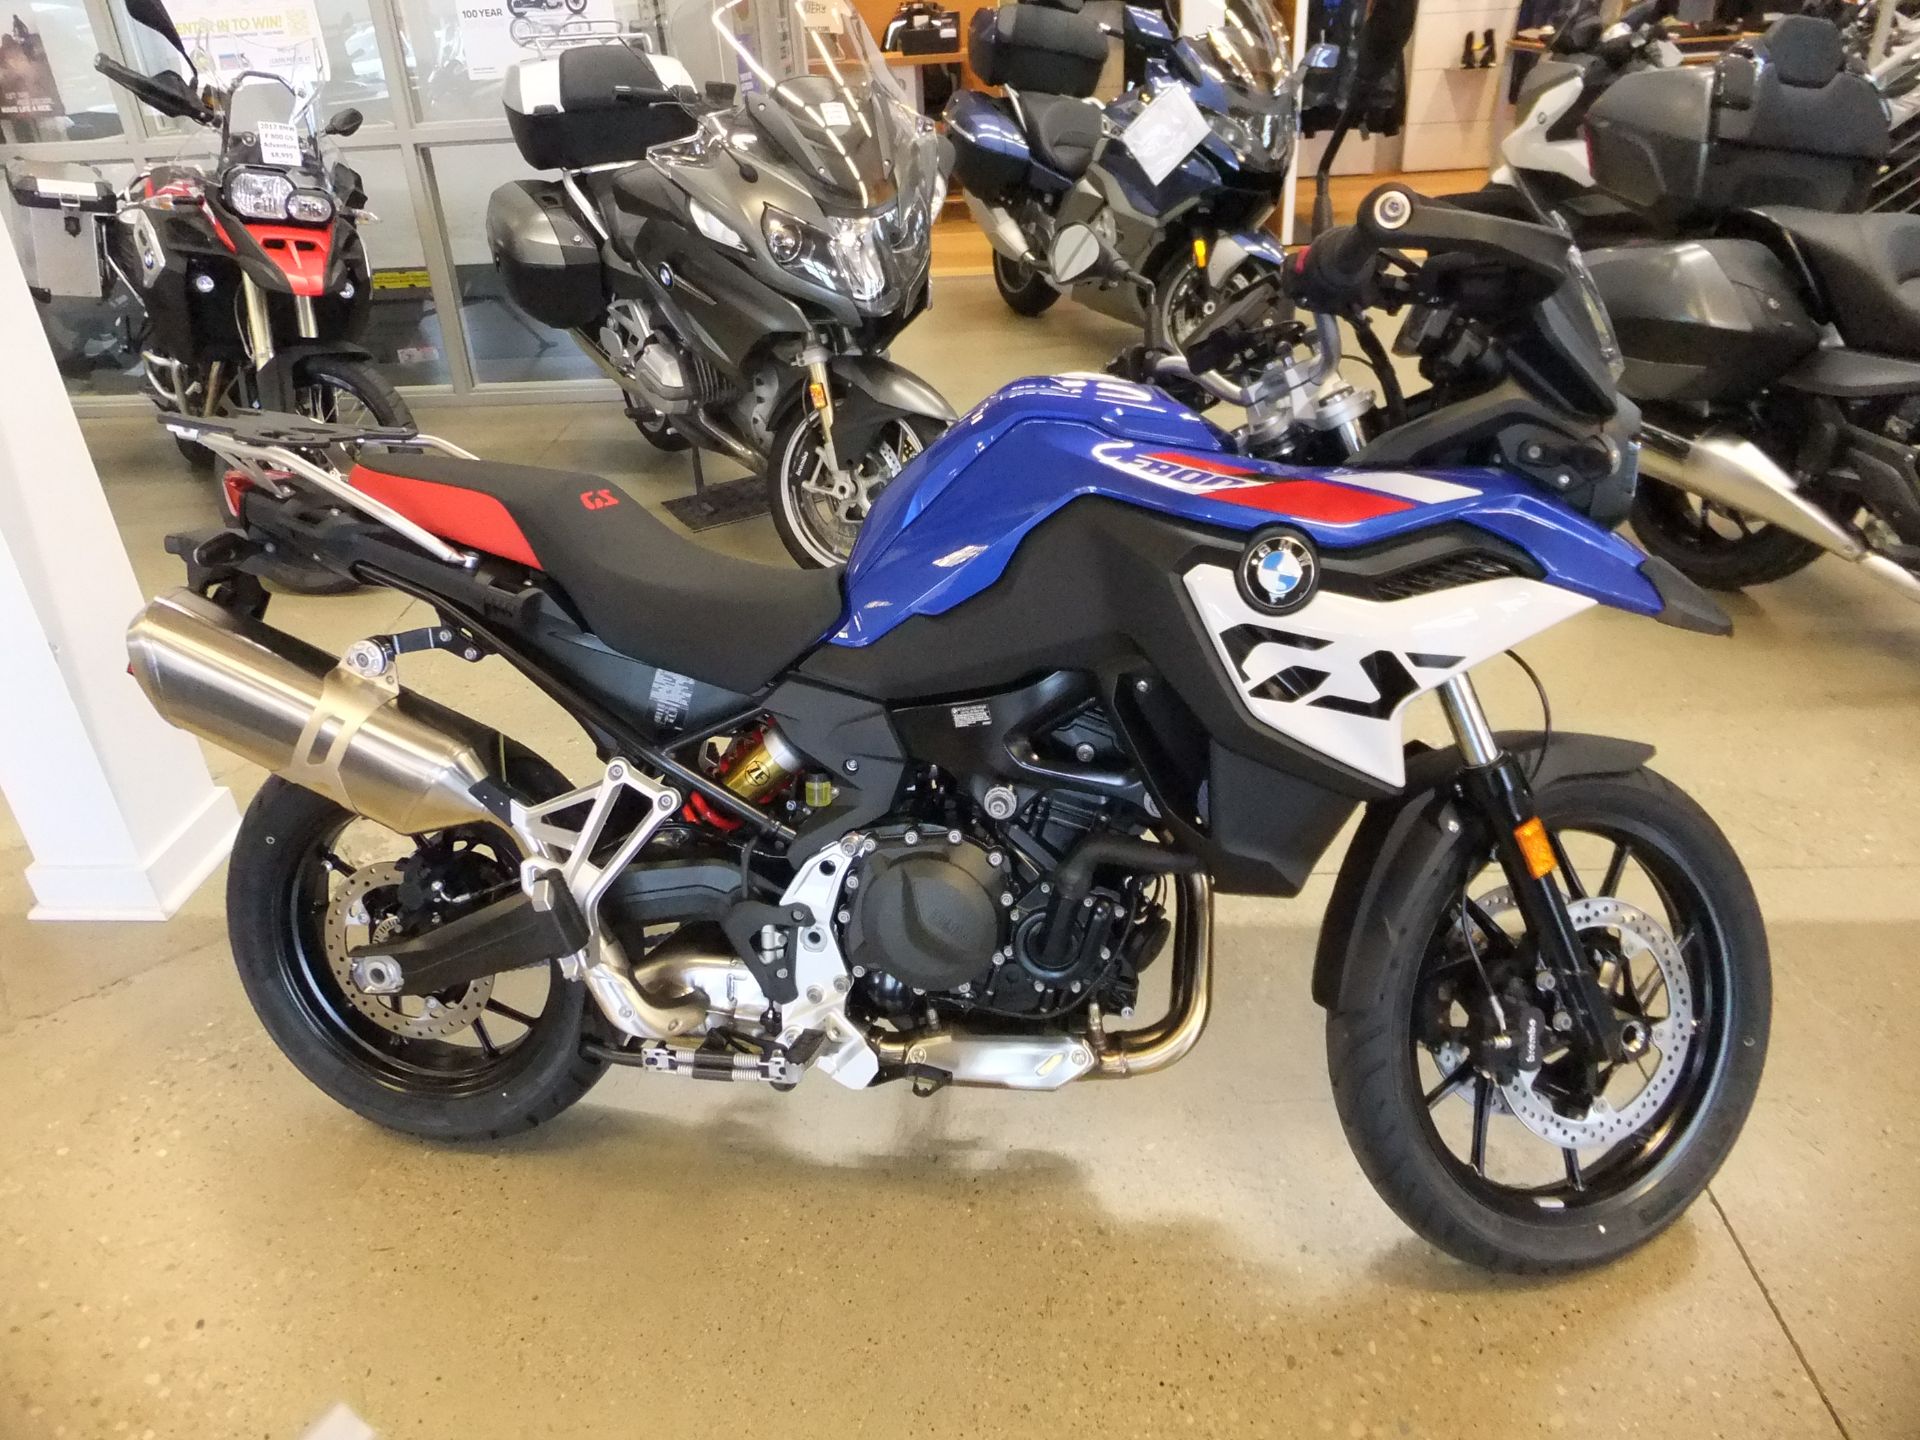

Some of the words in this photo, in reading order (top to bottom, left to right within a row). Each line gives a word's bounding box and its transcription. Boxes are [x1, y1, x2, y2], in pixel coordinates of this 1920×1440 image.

[232, 18, 250, 31] TO
[251, 15, 282, 29] WIN!
[462, 9, 478, 19] 100
[479, 8, 503, 18] YEAR
[580, 489, 619, 510] GS
[746, 761, 770, 786] ZF
[1525, 1018, 1537, 1063] brembo
